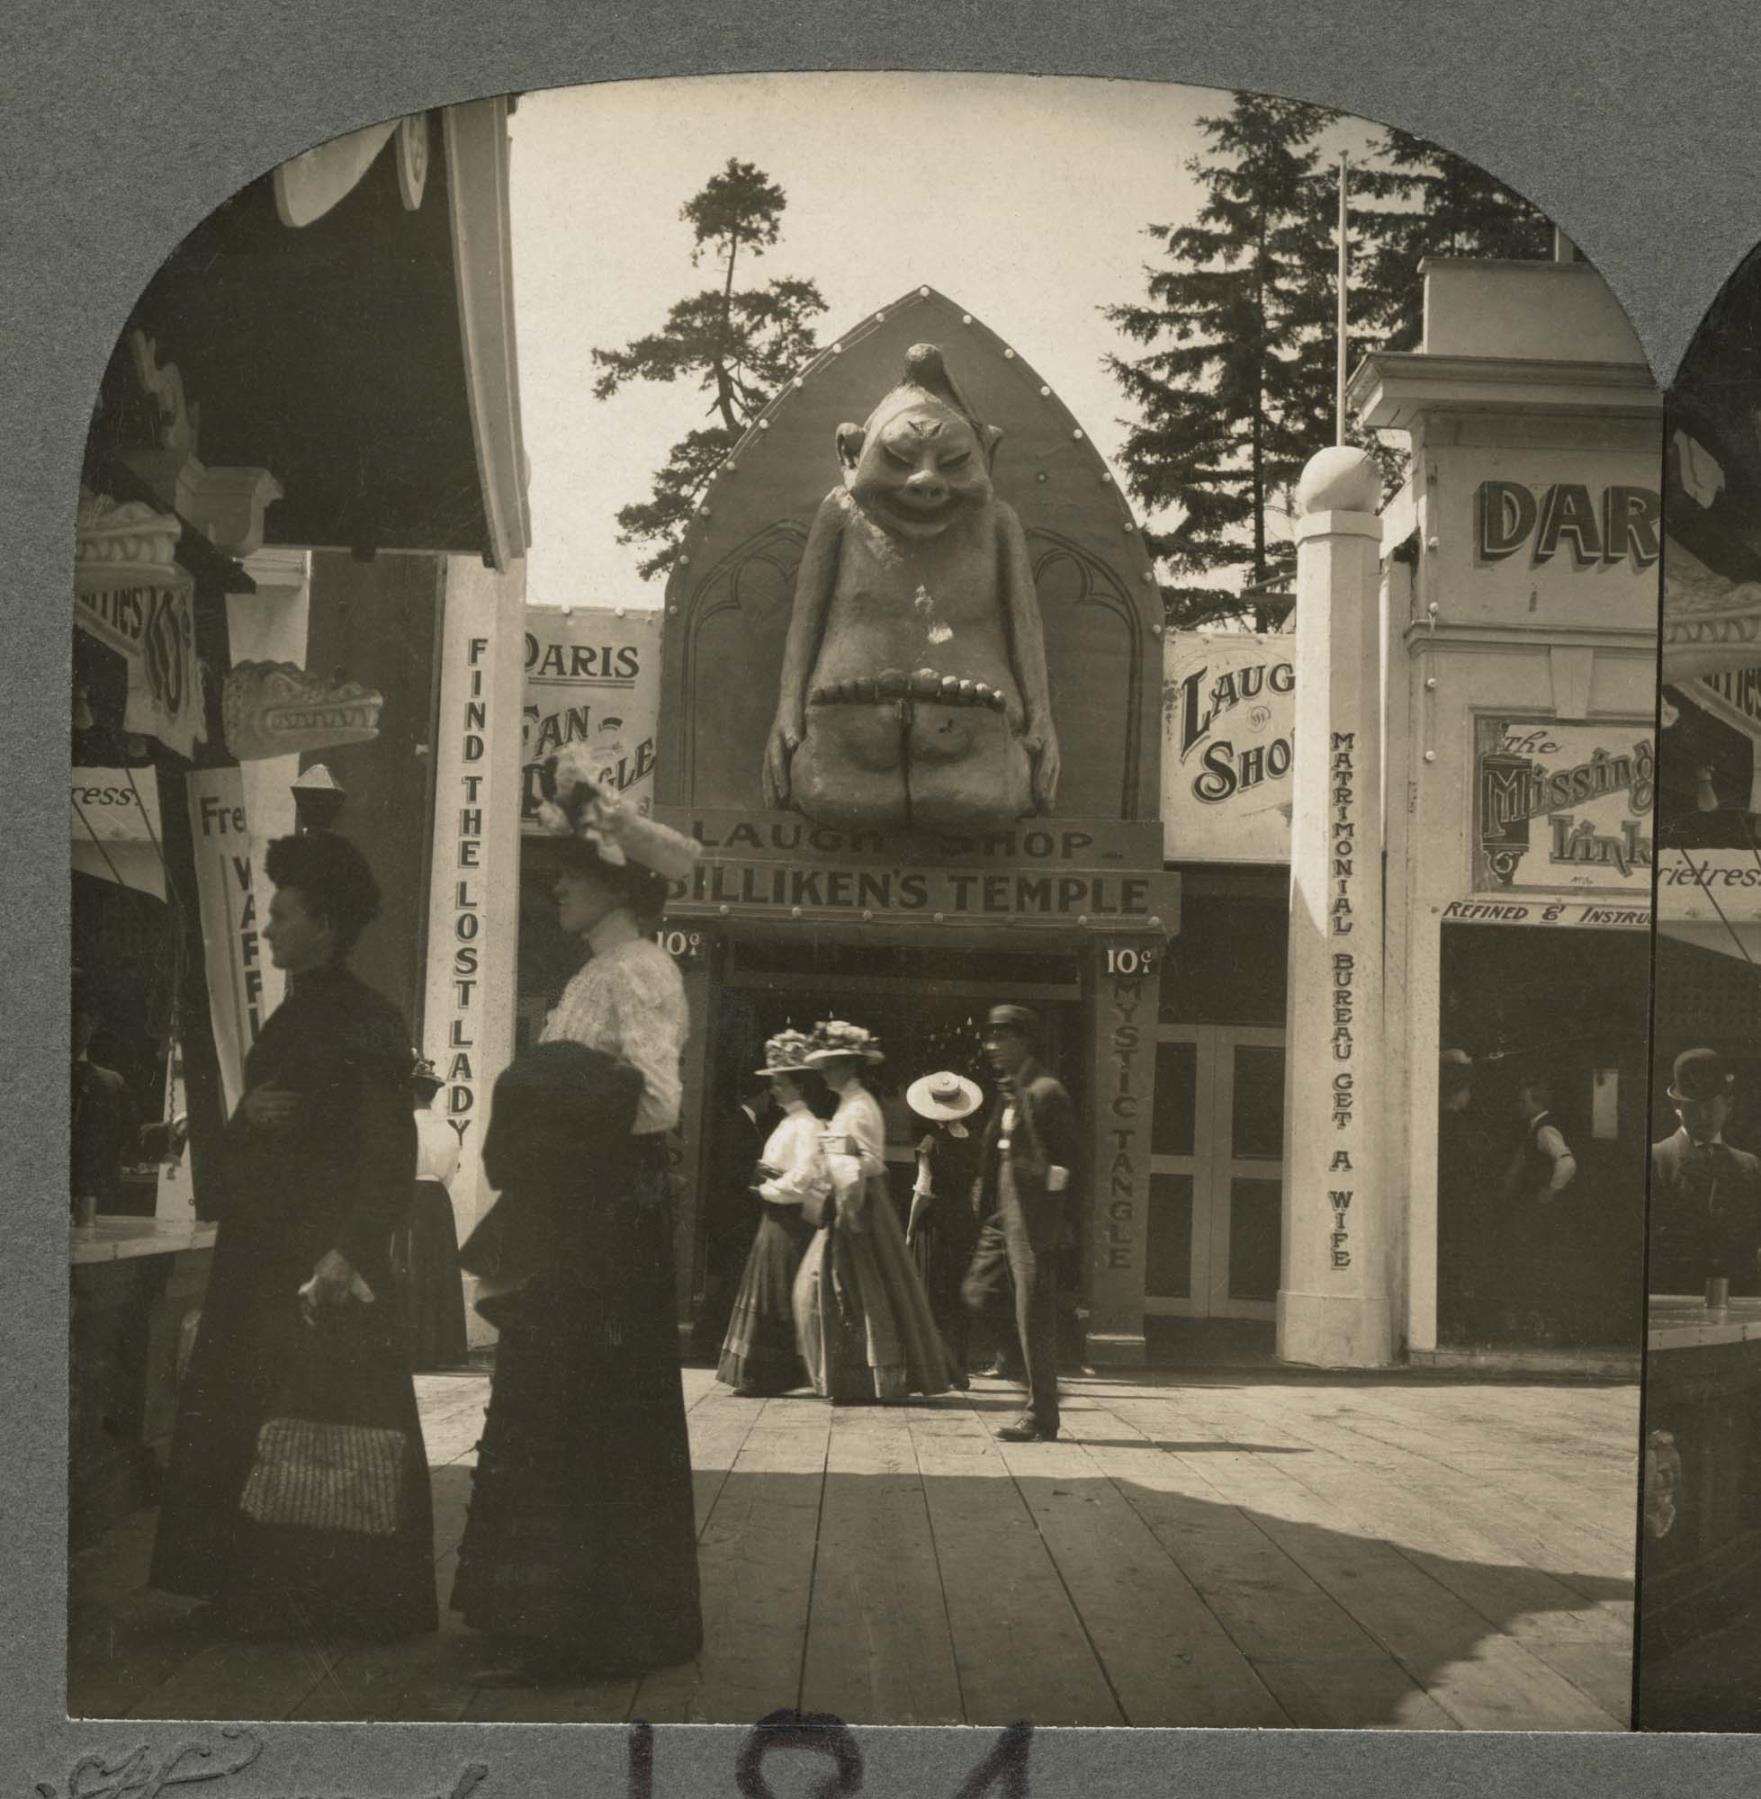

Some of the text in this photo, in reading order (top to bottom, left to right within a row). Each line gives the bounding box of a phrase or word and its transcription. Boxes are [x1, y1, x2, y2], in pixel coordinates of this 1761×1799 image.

[1474, 480, 1661, 572] DAR
[1180, 663, 1295, 765] LAUG
[1503, 731, 1561, 754] The
[1192, 728, 1295, 805] SHO
[1483, 739, 1654, 839] Missing
[1548, 814, 1653, 878] Link
[1657, 860, 1761, 887] rietres
[447, 638, 488, 1148] FIND THE LOST LADY
[947, 874, 1150, 915] TEMPLE
[1443, 901, 1528, 921] REFINED
[1541, 904, 1566, 921] &
[1330, 732, 1355, 1271] MATRIMONIAL BUREAU GET A WIFE
[1109, 981, 1141, 1270] MYSTIC TANGLE
